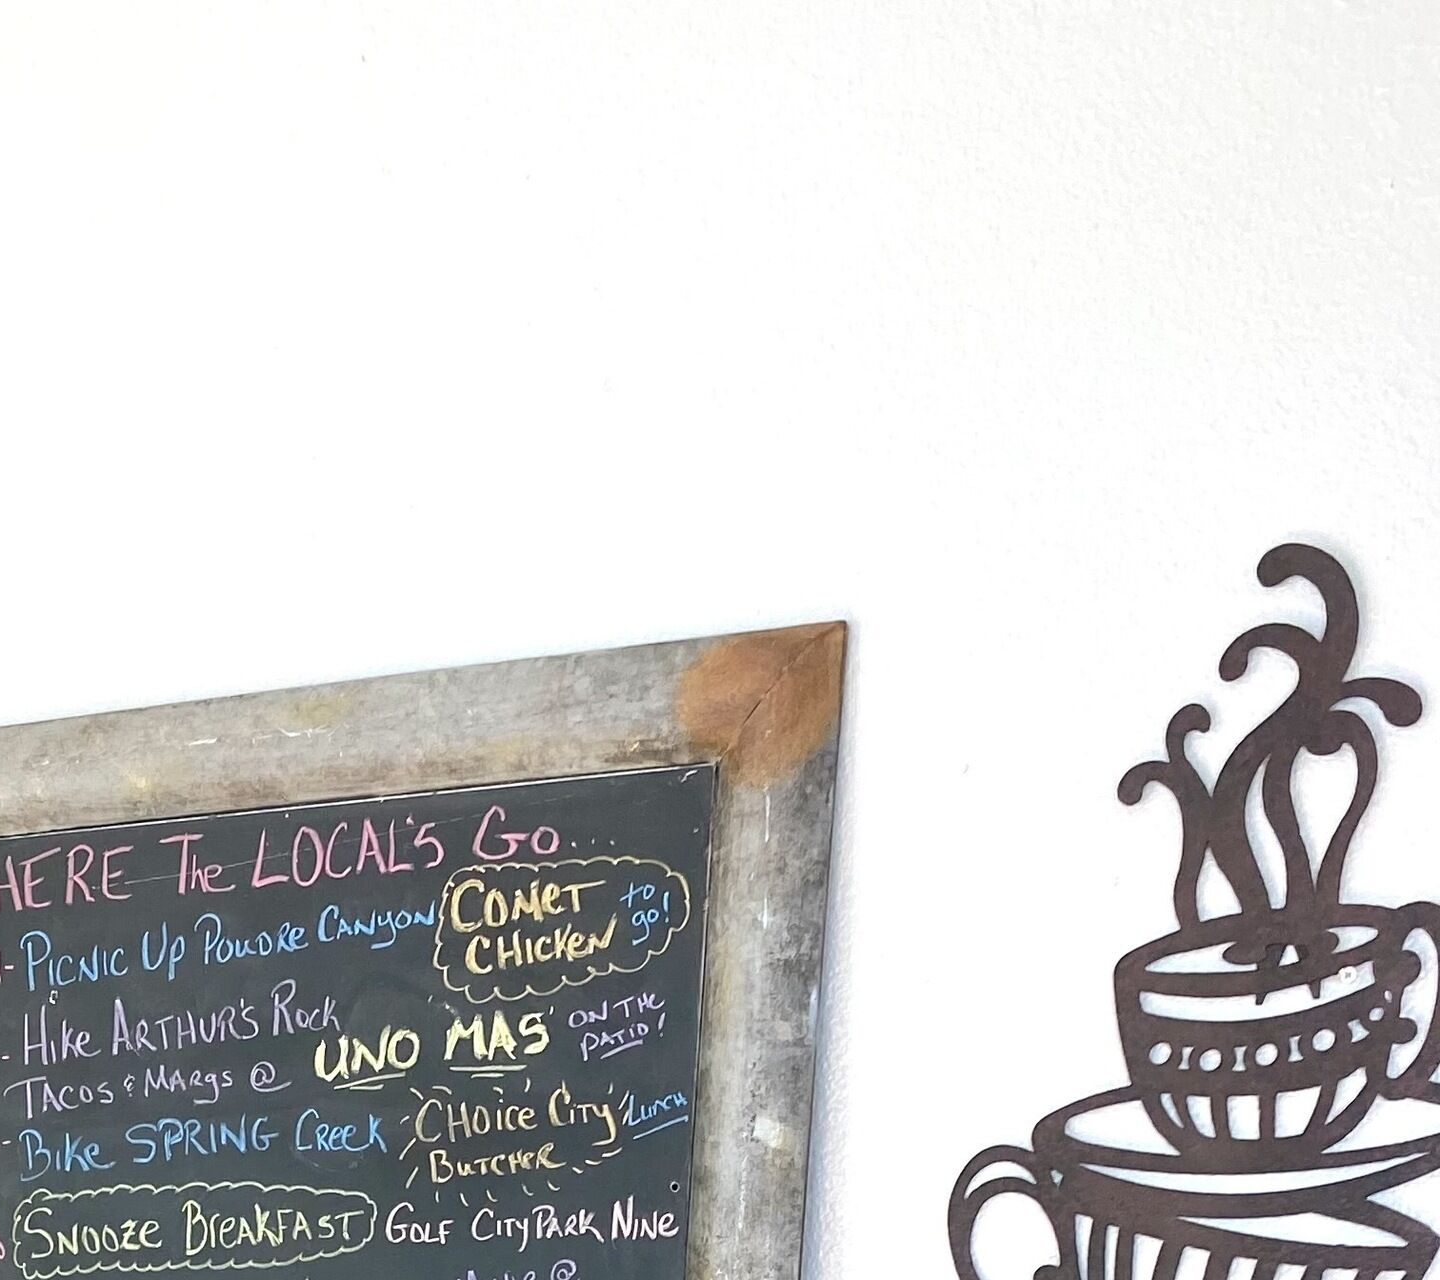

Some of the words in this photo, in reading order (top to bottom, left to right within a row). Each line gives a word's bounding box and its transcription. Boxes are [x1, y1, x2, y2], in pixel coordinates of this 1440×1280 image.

[160, 833, 236, 895] The
[252, 815, 444, 889] LOCAL'S
[620, 882, 656, 904] to
[20, 930, 128, 991] PICNIC
[111, 997, 260, 1057] ARTHUR'S
[568, 1000, 609, 1028] ON
[314, 1025, 420, 1082] UNO
[443, 1010, 552, 1061] MAS
[3, 1075, 114, 1120] TACOS
[250, 1062, 292, 1092] @
[125, 1114, 279, 1164] SPRING
[385, 1202, 455, 1245] GOLF
